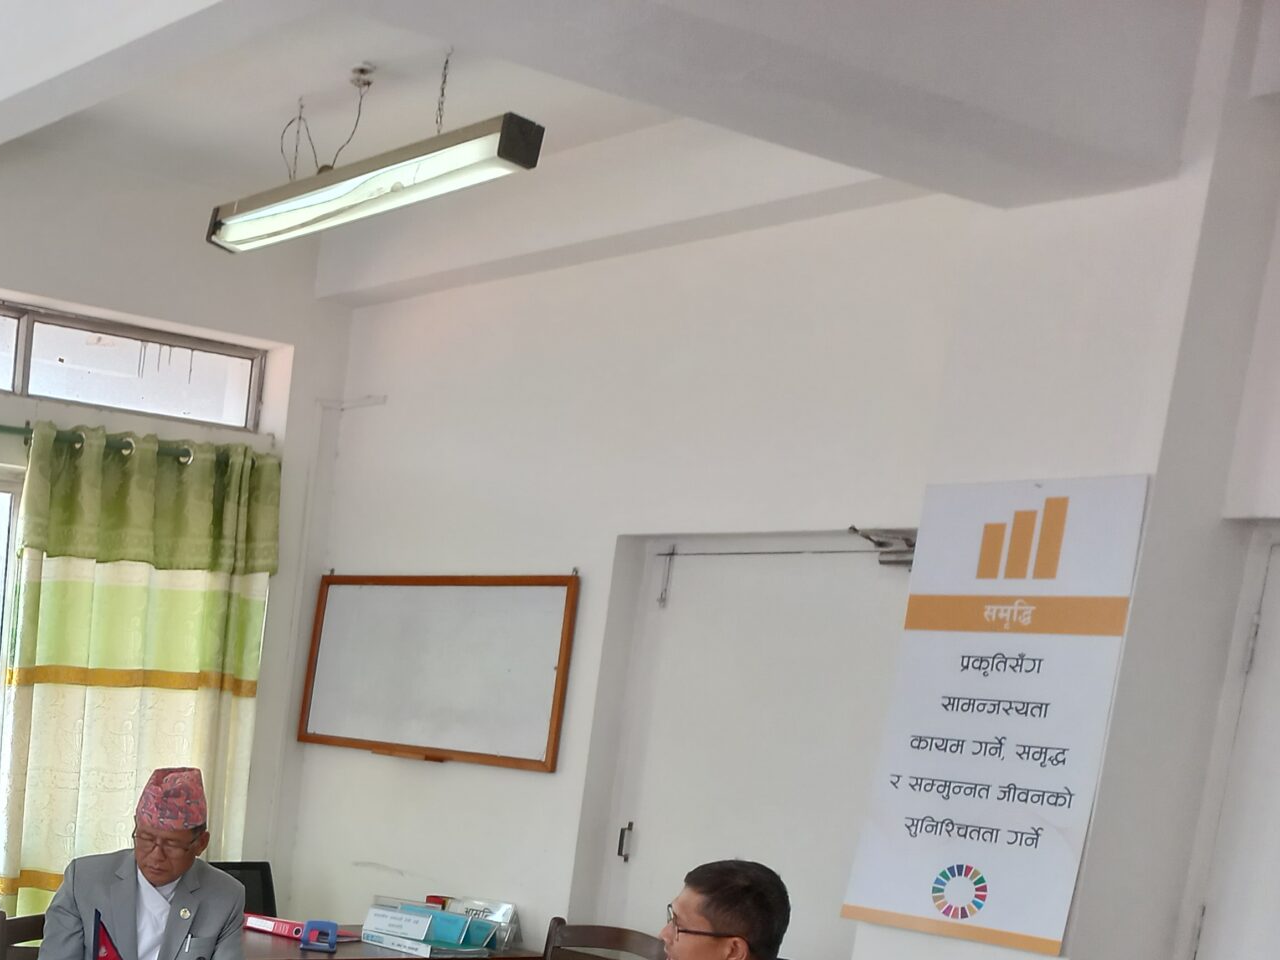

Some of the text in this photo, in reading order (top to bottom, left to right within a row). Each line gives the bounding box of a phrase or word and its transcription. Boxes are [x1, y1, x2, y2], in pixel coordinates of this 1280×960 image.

[984, 599, 1036, 629] समृद्धि
[960, 652, 1044, 677] प्रकृतिसँग
[941, 695, 1050, 718] सामन्जस्यता
[910, 735, 1069, 767] कायम गर्ने, समृद्ध
[890, 774, 1074, 808] र सम्मुन्नत जीवनको
[905, 816, 1043, 848] सुनिश्चितता गर्ने
